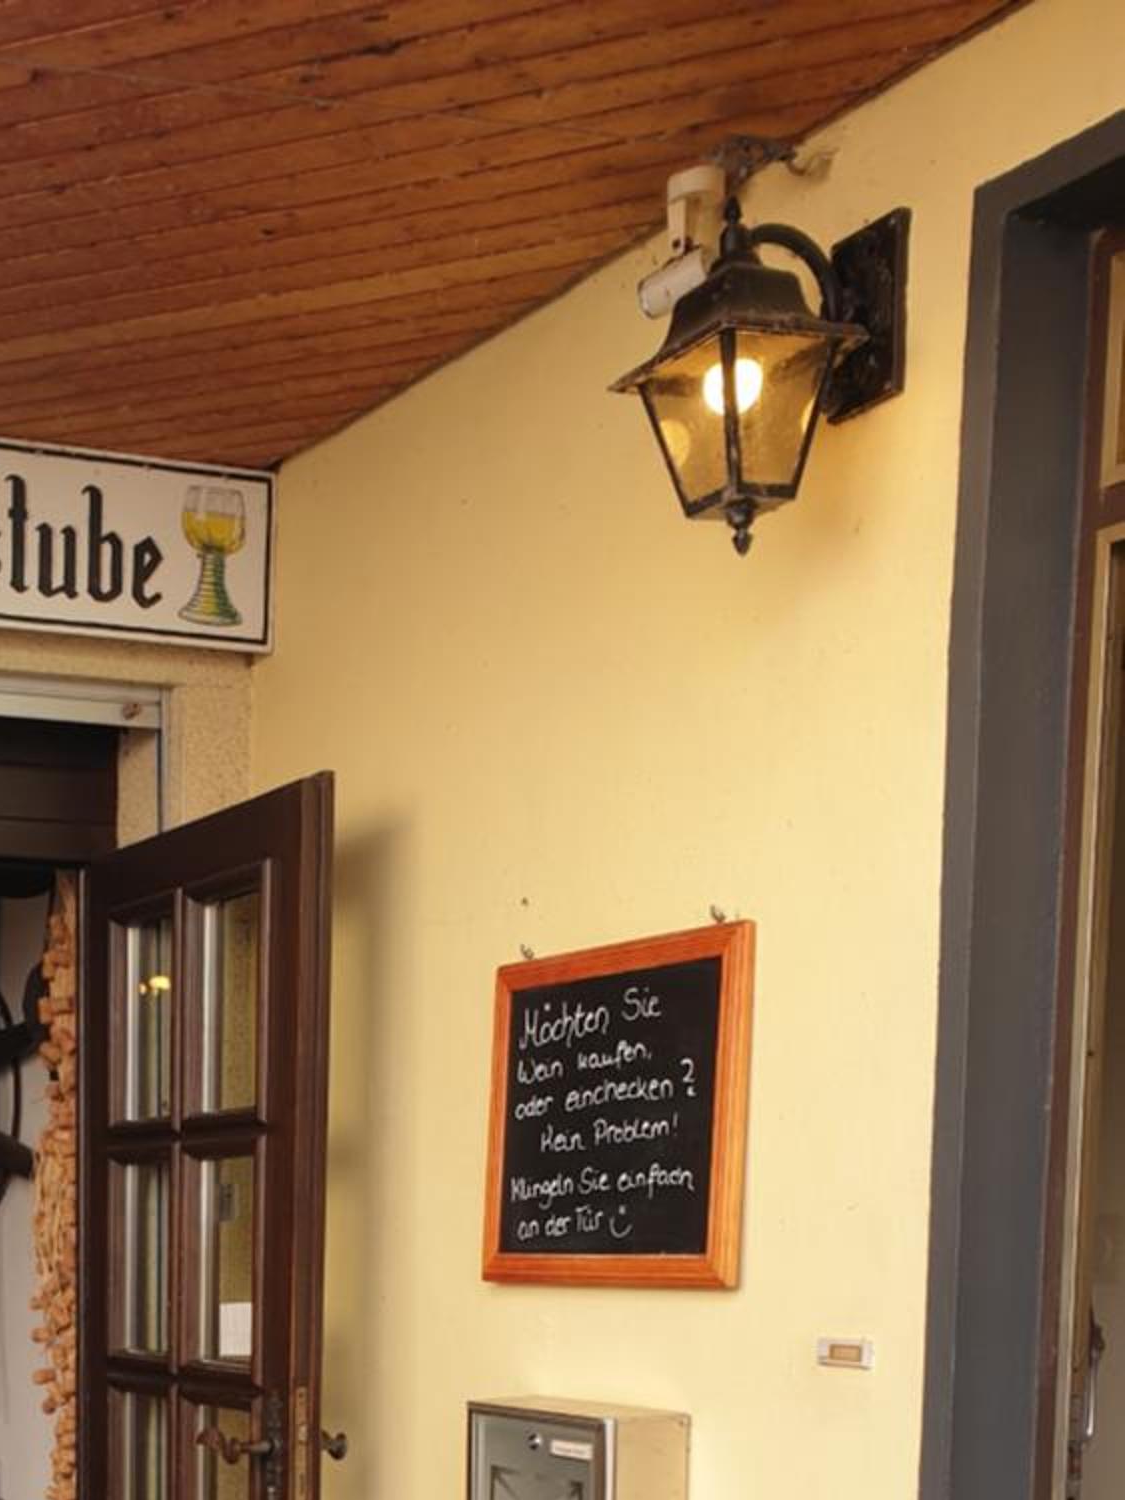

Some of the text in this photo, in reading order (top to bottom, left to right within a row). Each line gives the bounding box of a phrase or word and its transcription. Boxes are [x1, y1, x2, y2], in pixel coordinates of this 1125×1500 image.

[518, 987, 662, 1050] Möchten Sie
[516, 1058, 564, 1084] Wein
[514, 1095, 554, 1120] oder
[564, 1076, 674, 1112] einchecken
[540, 1112, 679, 1152] Kein Problem!
[510, 1162, 695, 1210] Klingeln Sie einfach
[517, 1204, 604, 1241] an der Tür
